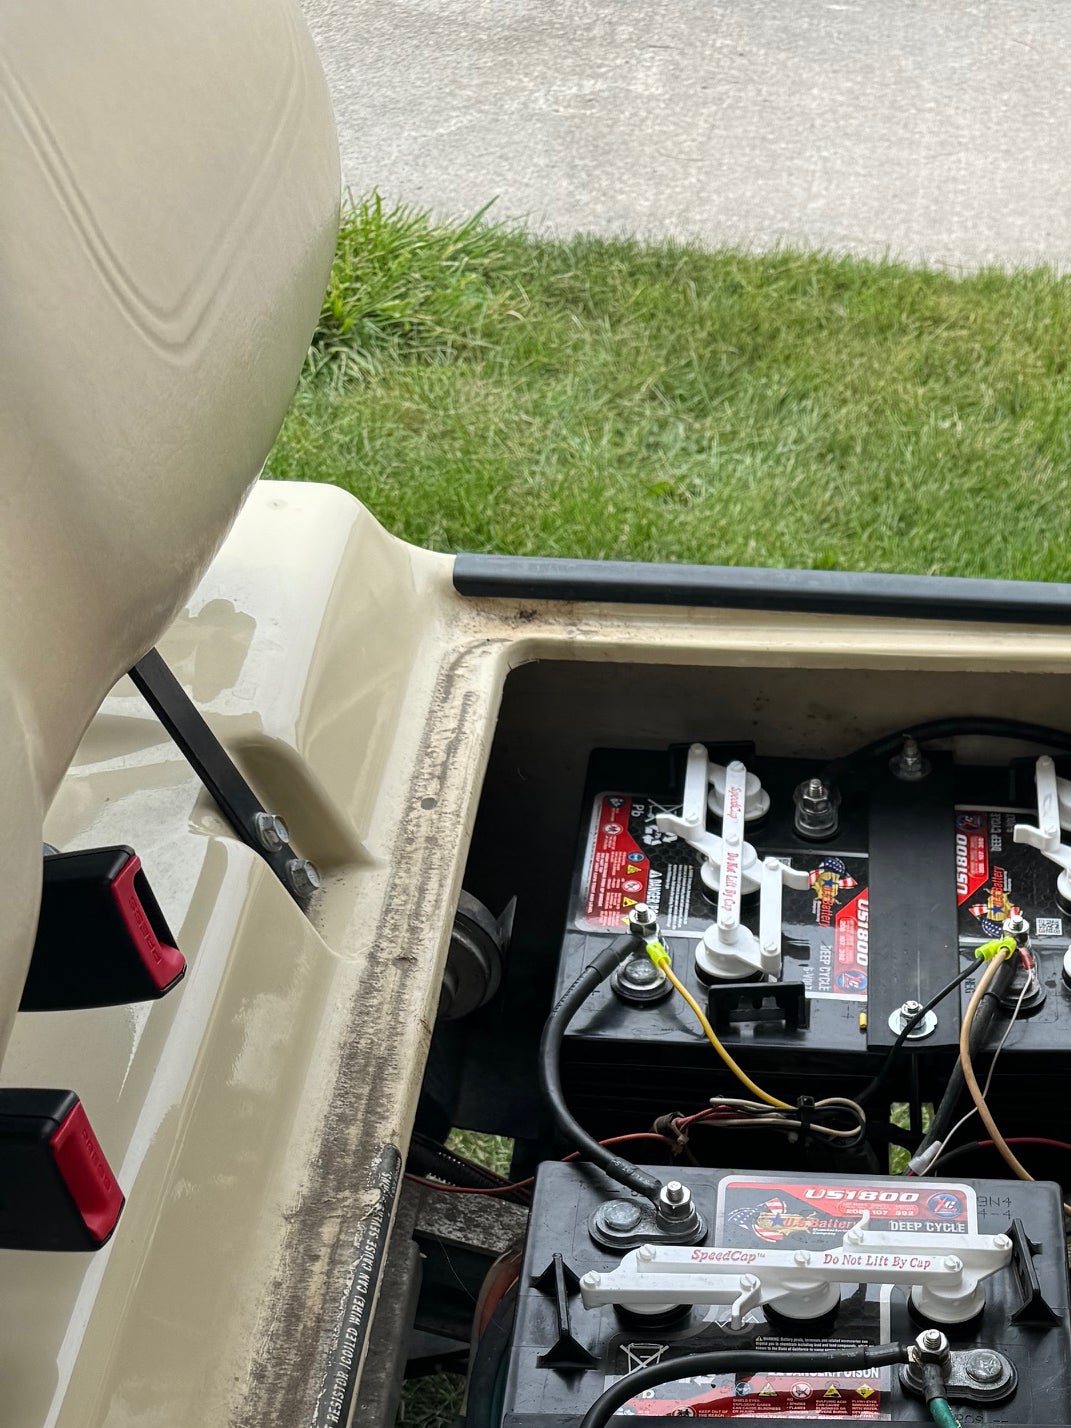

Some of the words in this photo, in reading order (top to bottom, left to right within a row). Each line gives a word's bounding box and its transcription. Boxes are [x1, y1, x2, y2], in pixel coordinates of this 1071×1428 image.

[631, 804, 645, 817] Pb
[990, 811, 1002, 832] CYCLE
[991, 834, 1003, 851] DEEP
[957, 834, 968, 894] US1800
[857, 899, 868, 966] US1800
[818, 966, 832, 991] CYCLE
[805, 1188, 920, 1203] US1800
[872, 1208, 888, 1216] 107
[891, 1220, 921, 1234] DEEP
[927, 1221, 965, 1235] CYCLE
[361, 1240, 381, 1271] CAUSE
[823, 1251, 839, 1266] Do
[842, 1252, 861, 1268] Not
[866, 1253, 887, 1269] Lift
[892, 1255, 906, 1270] By
[909, 1256, 934, 1272] Cap
[357, 1272, 374, 1294] CAN
[345, 1294, 364, 1324] WIRE)
[336, 1326, 358, 1368] (COILED
[326, 1370, 349, 1422] RESISTOR
